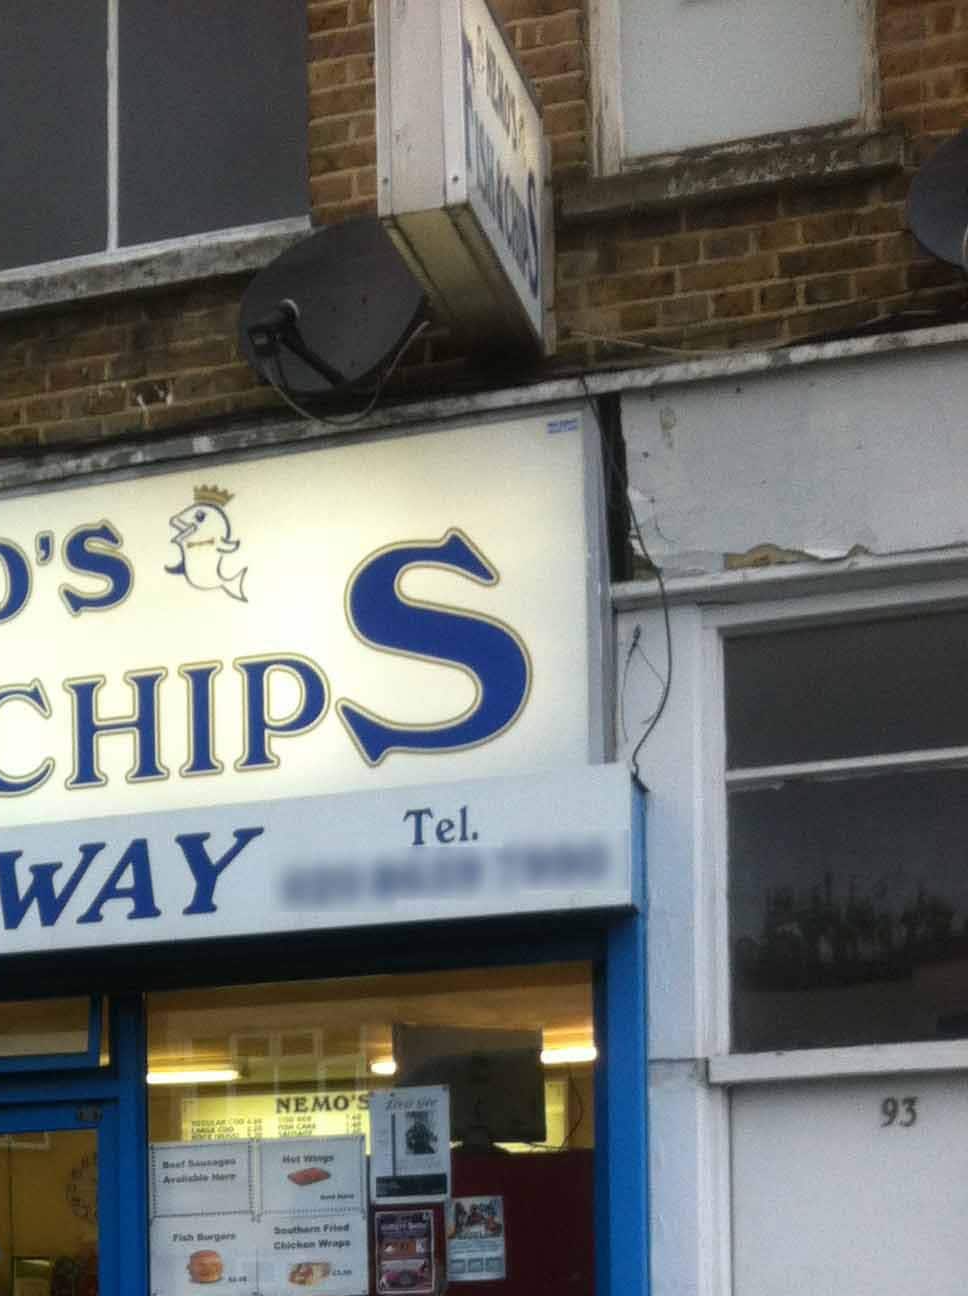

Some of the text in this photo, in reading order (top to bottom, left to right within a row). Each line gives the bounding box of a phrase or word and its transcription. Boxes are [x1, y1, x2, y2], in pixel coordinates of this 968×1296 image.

[403, 806, 479, 846] Tel.
[275, 1094, 370, 1114] NEMO'S
[881, 1096, 919, 1127] 93
[282, 1154, 300, 1164] Hot
[273, 1223, 350, 1235] Southern Fried
[172, 1231, 236, 1243] Fish Burgers
[273, 1238, 351, 1250] Chicken Wraps
